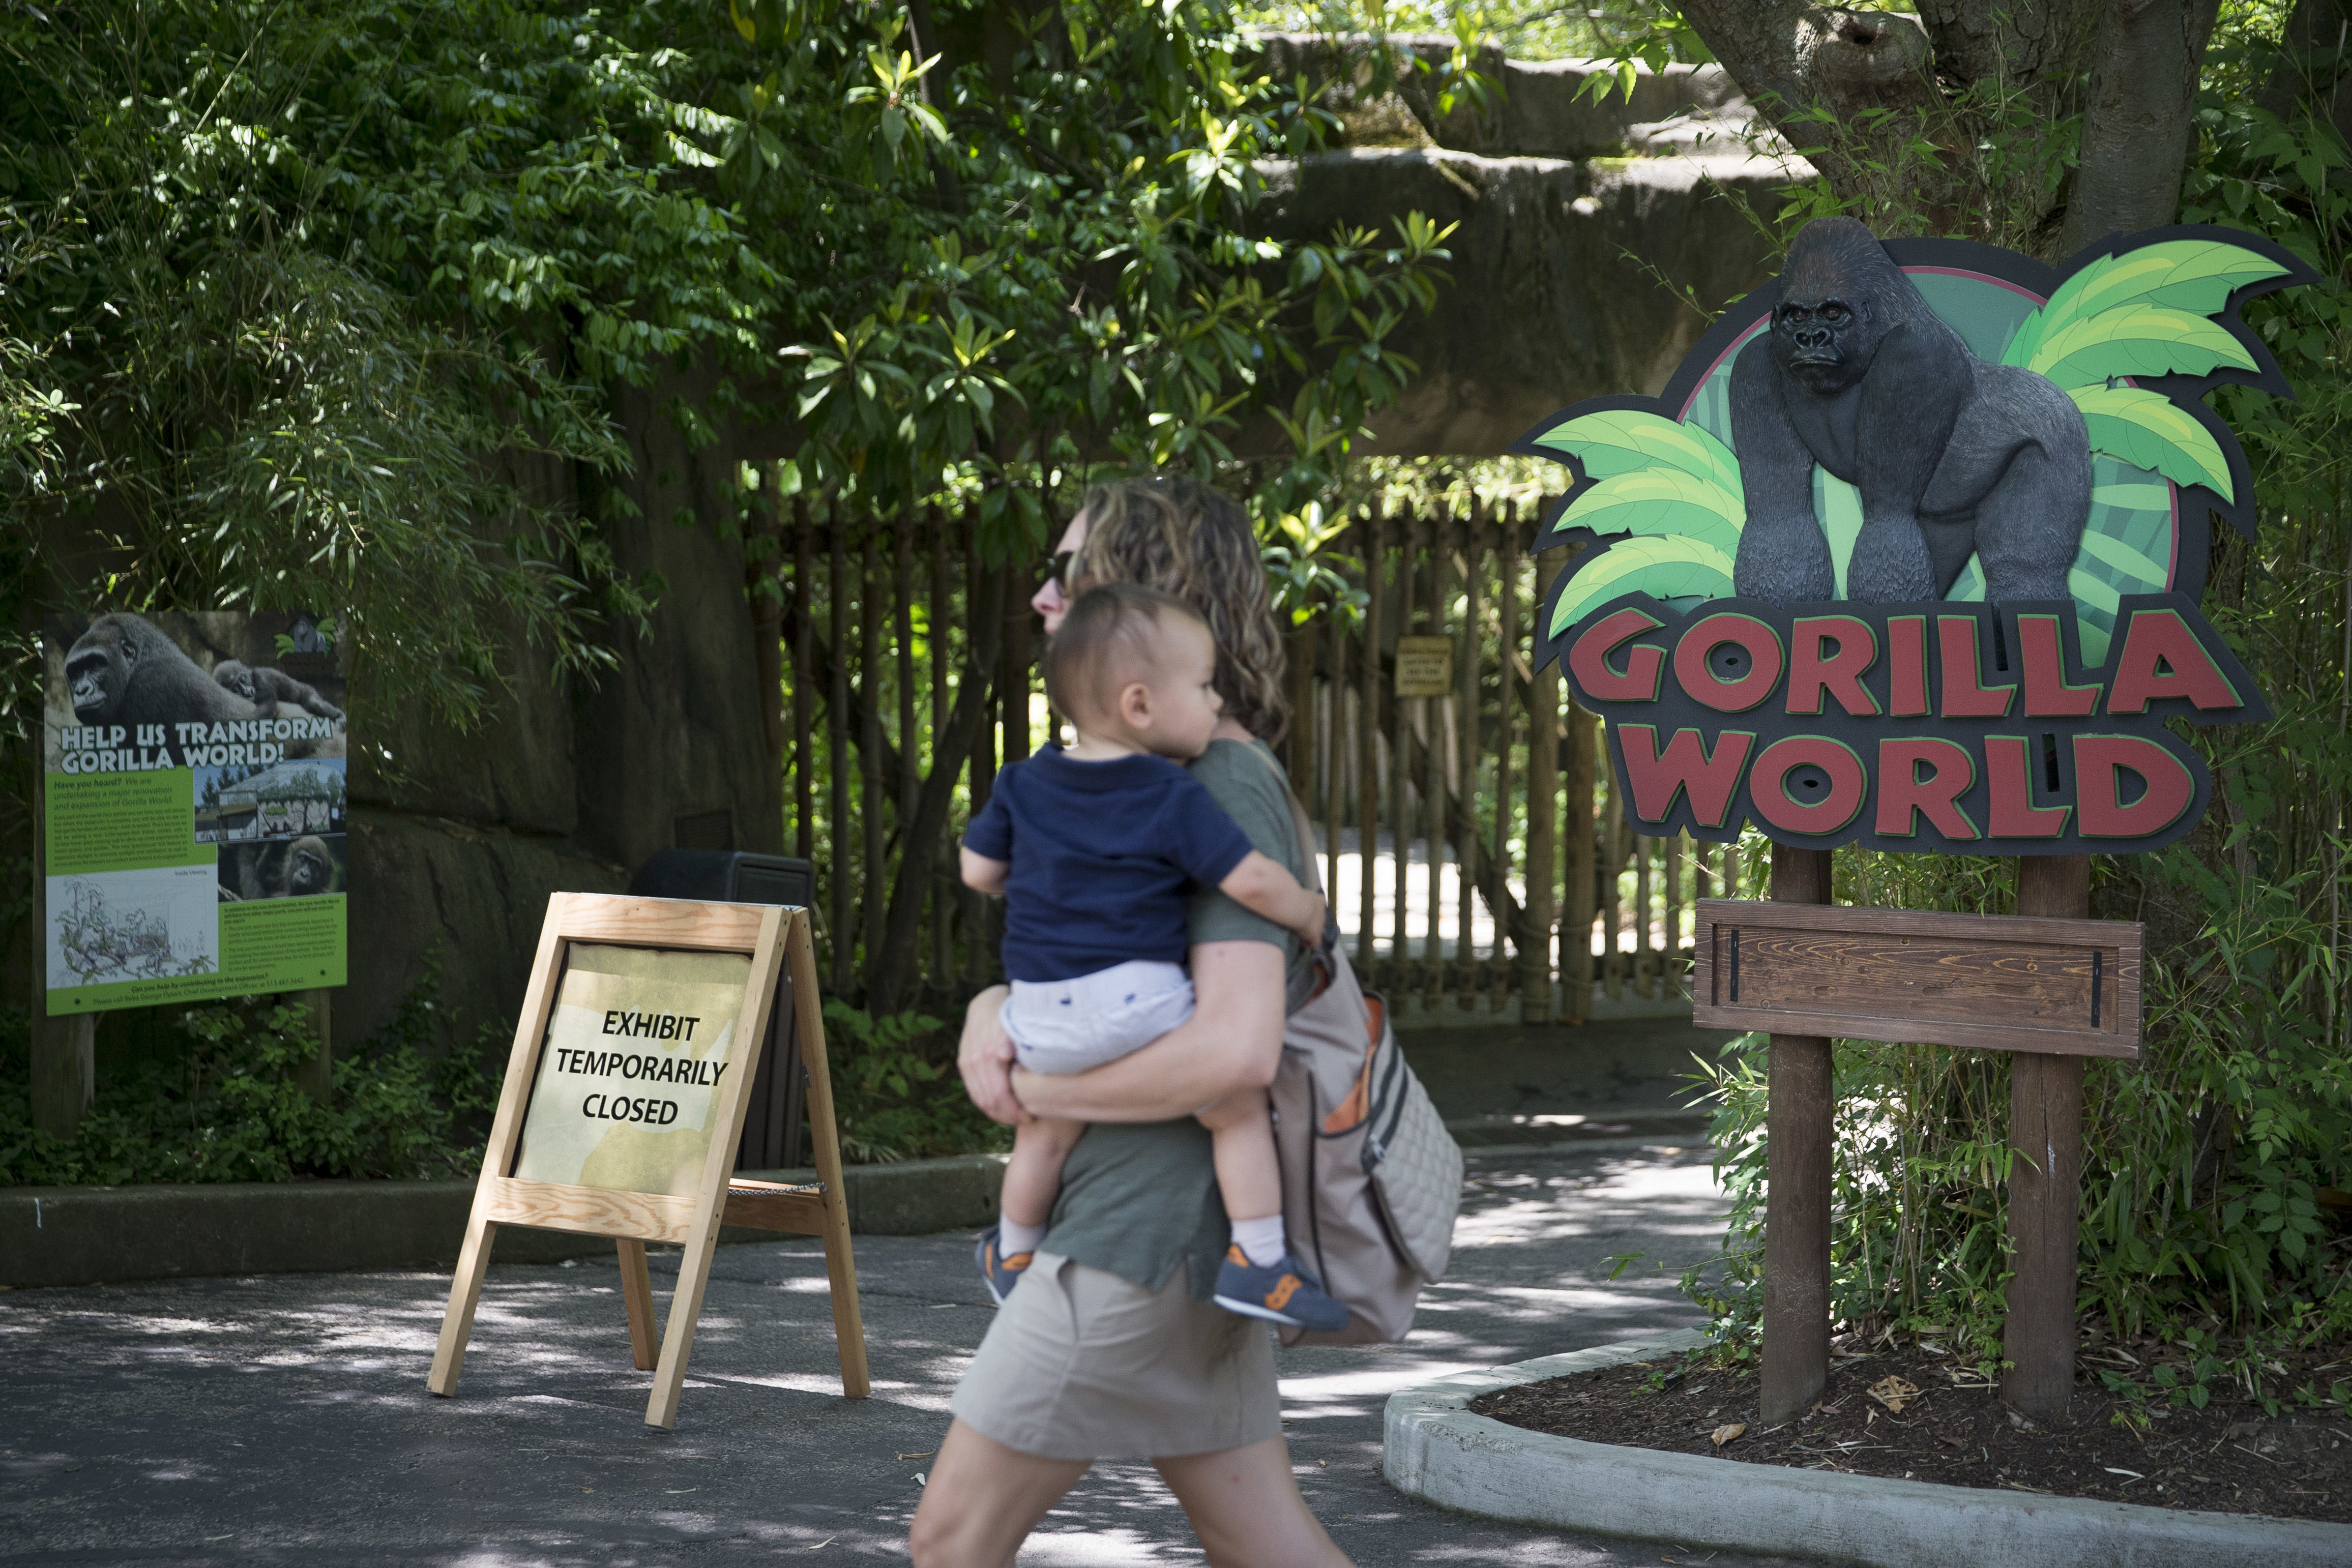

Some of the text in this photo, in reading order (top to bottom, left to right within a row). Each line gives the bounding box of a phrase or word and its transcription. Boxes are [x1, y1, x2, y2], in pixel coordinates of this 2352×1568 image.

[1569, 607, 2244, 717] GORILLA
[61, 717, 332, 751] HELP US TRANSFORM
[61, 742, 284, 775] GORILLA WORLD!
[54, 781, 75, 789] Have
[76, 782, 92, 790] you
[94, 777, 122, 787] heard?
[125, 777, 138, 785] We
[54, 790, 100, 800] undertaking
[108, 789, 130, 797] major
[132, 786, 172, 795] renovation
[1617, 723, 2194, 840] WORLD
[54, 802, 69, 811] and
[71, 800, 110, 811] expansion
[122, 797, 147, 807] Gorilla
[602, 1010, 700, 1041] EXHIBIT
[557, 1048, 729, 1086] TEMPORARILY
[582, 1093, 679, 1125] CLOSED
